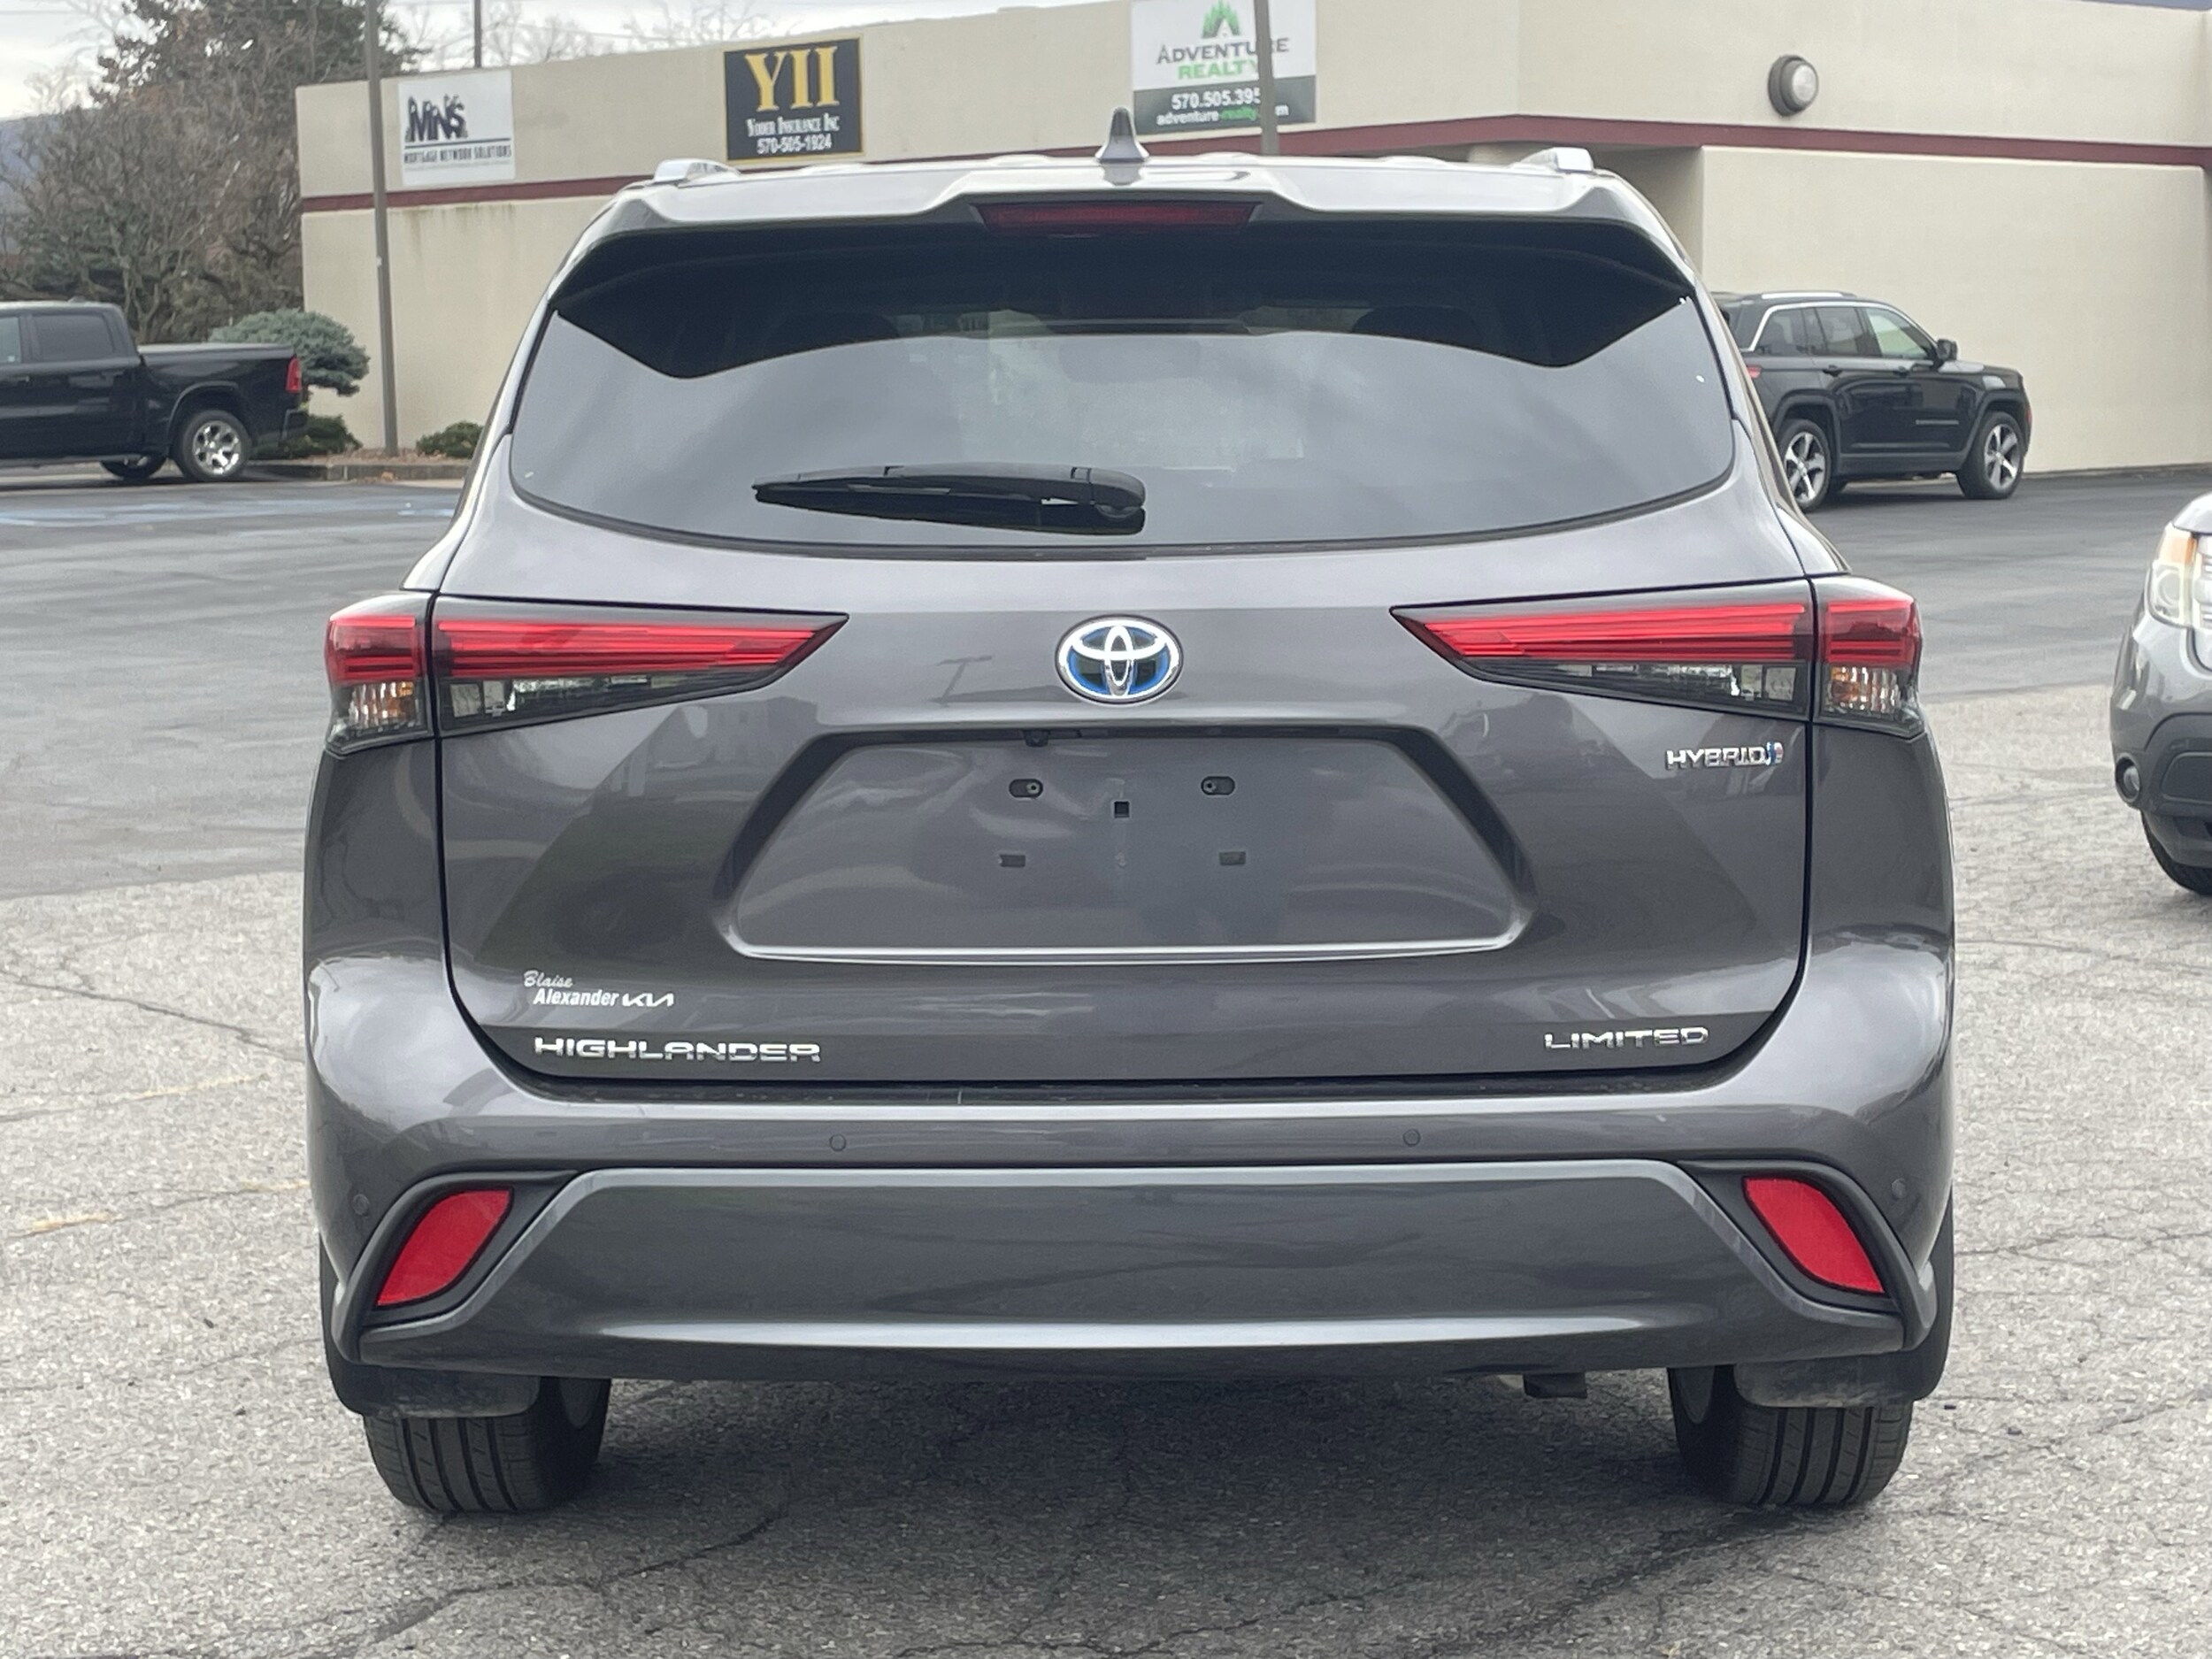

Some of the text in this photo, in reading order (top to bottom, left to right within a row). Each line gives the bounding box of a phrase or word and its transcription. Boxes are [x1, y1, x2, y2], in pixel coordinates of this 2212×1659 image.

[1156, 38, 1290, 64] ADVENTUE
[744, 46, 840, 111] YII
[1666, 746, 1769, 770] HYBRID
[524, 970, 573, 987] Blaise
[533, 988, 619, 1006] Alexander
[1544, 1026, 1709, 1049] LIMITED
[534, 1037, 821, 1063] HIGHLANDER
